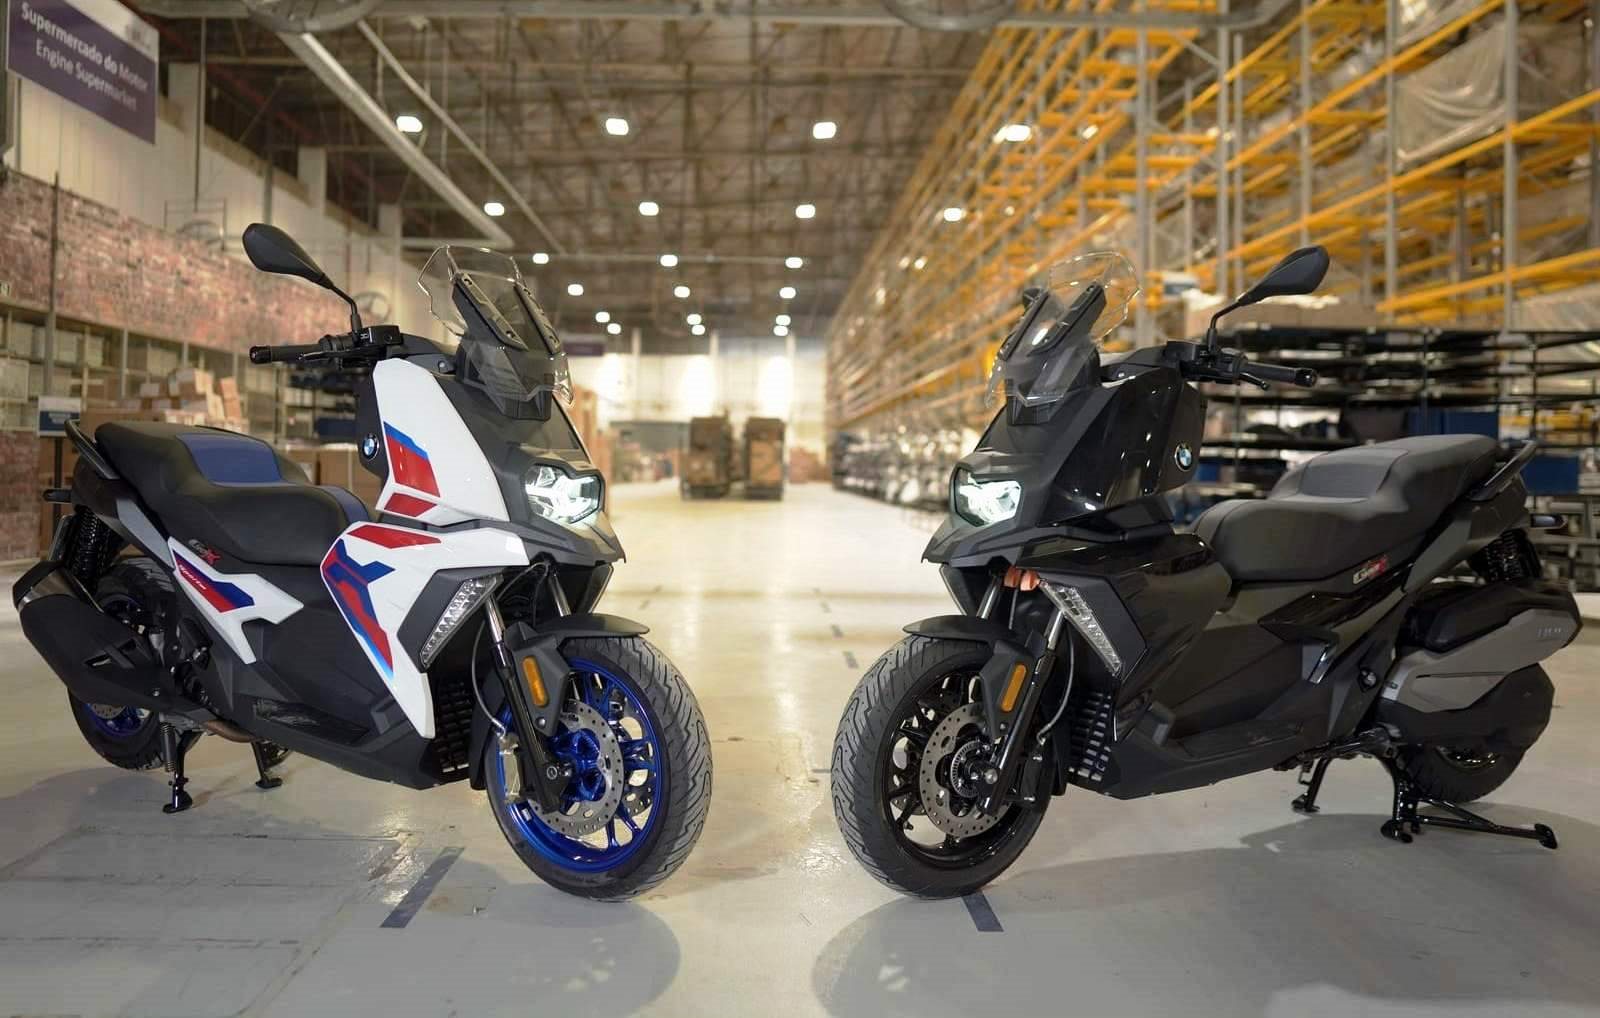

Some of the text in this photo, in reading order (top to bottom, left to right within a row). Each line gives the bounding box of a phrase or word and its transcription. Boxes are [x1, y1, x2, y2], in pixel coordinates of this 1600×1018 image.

[21, 1, 102, 65] Supermercado
[104, 54, 118, 75] do
[36, 38, 74, 75] Engine
